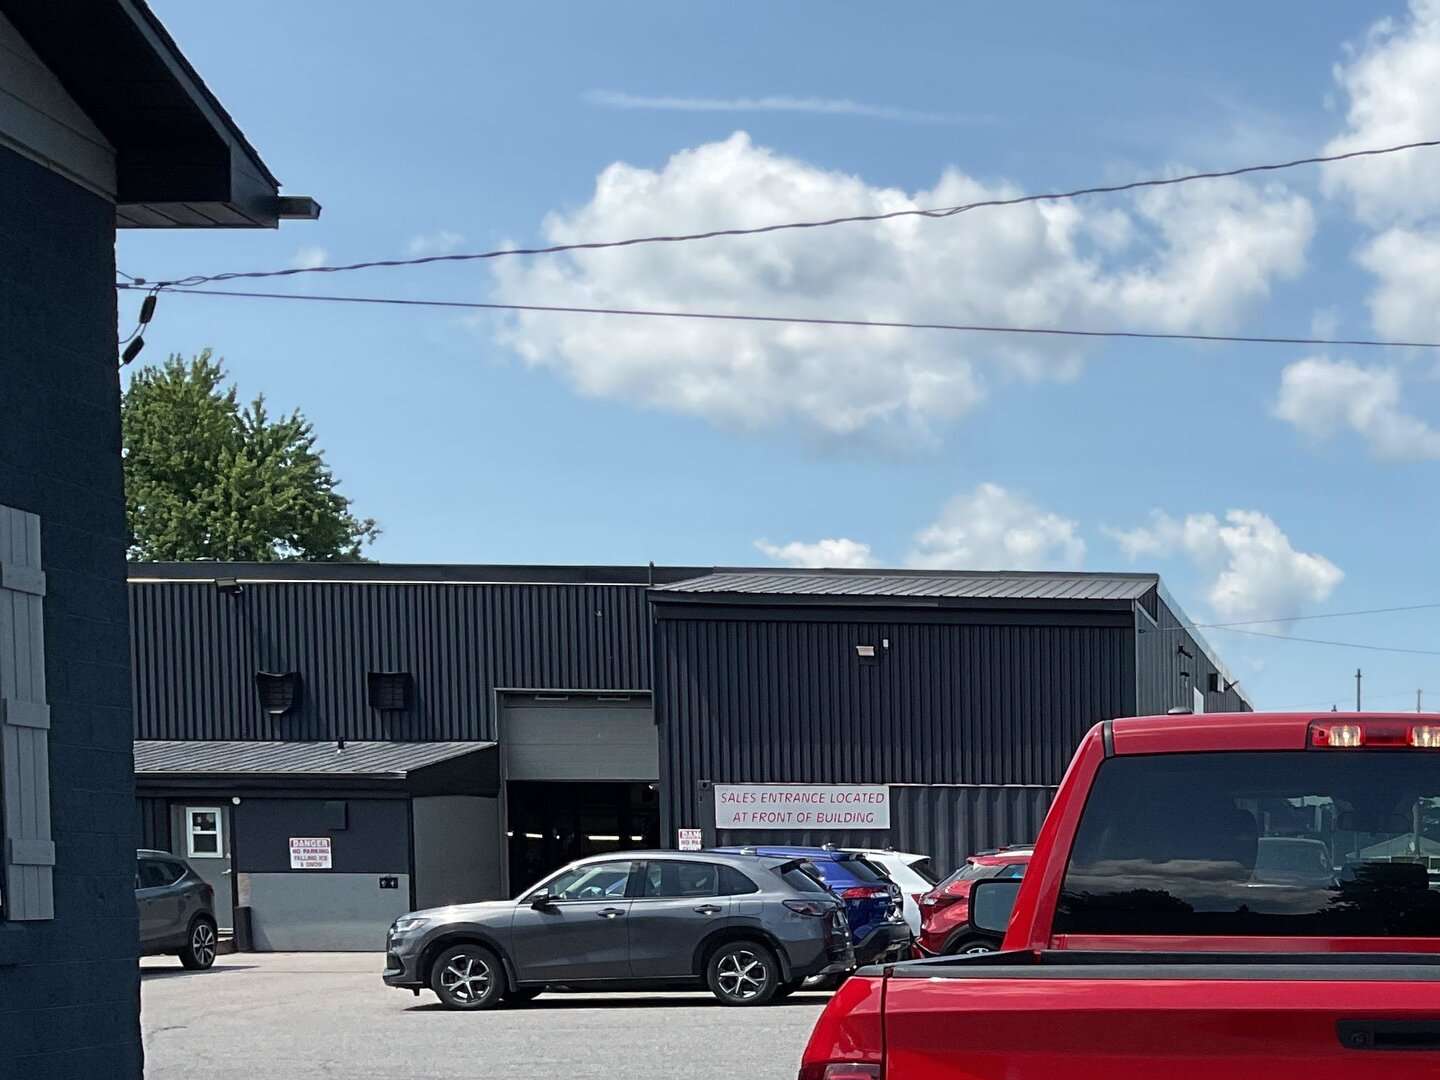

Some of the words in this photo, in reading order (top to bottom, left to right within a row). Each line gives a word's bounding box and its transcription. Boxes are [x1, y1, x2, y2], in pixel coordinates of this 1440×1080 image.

[721, 792, 756, 804] SALES
[760, 792, 825, 804] ENTRANCE
[830, 792, 885, 804] LOCATED
[732, 812, 748, 823] AT
[751, 812, 793, 823] FRONT
[796, 812, 812, 823] OF
[816, 812, 874, 823] BUILDING
[682, 831, 701, 839] DAN
[292, 839, 328, 847] DANGER
